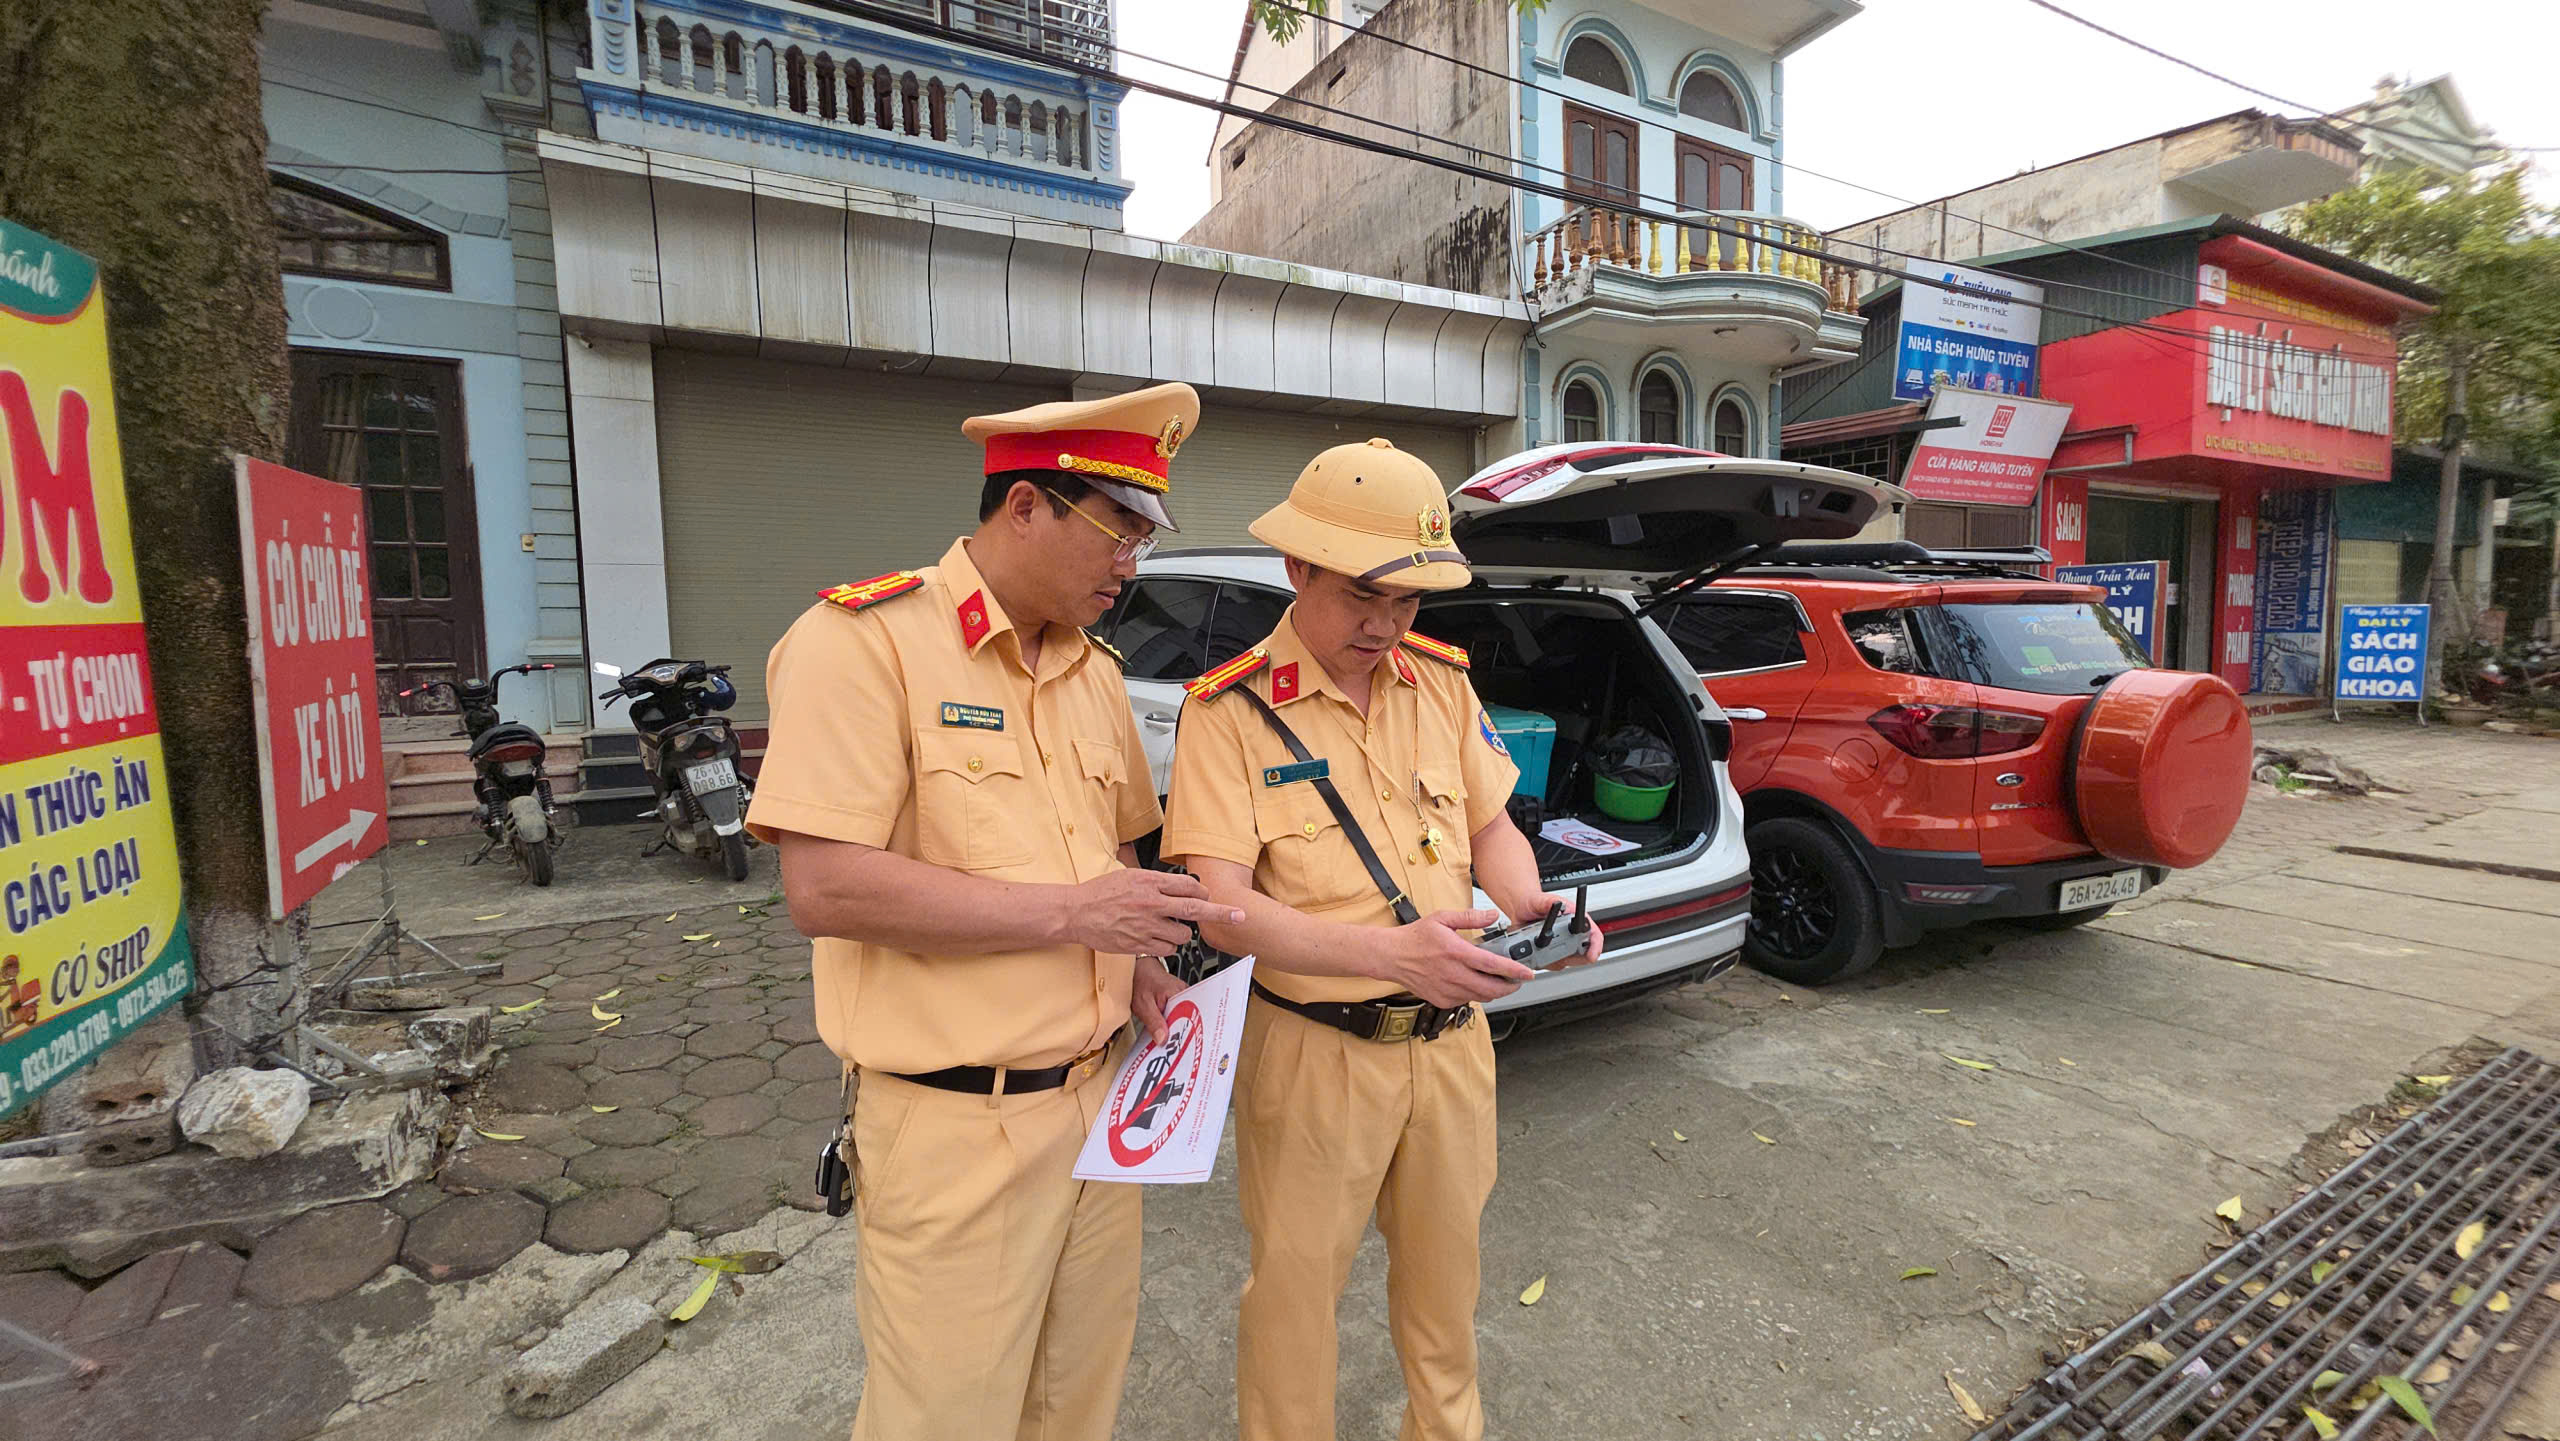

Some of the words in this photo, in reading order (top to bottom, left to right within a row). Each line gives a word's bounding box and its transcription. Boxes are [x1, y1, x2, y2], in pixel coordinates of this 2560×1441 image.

[1907, 333, 1932, 352] NHÀ
[1935, 337, 1964, 358] SÁCH
[0, 370, 113, 604] M
[1948, 455, 1978, 472] HÀNG
[2056, 494, 2081, 541] SÁCH
[266, 519, 300, 648] CÓ
[2058, 571, 2093, 585] Phùng
[2095, 569, 2121, 583] Trần
[2110, 584, 2133, 596] LÝ
[2350, 629, 2417, 650] SÁCH
[2347, 653, 2415, 674] GIÁO
[28, 651, 69, 744] TỰ
[72, 653, 144, 733] CHỌN
[2341, 678, 2417, 697] KHOA
[294, 702, 326, 808] XE
[326, 677, 342, 792] Ô
[340, 672, 365, 784] TÔ
[25, 766, 105, 837] THỨC
[112, 755, 150, 811] ĂN
[4, 861, 71, 934] CÁC
[76, 837, 141, 904] LOẠI
[51, 942, 89, 1006] CÓ
[95, 926, 150, 990] SHIP
